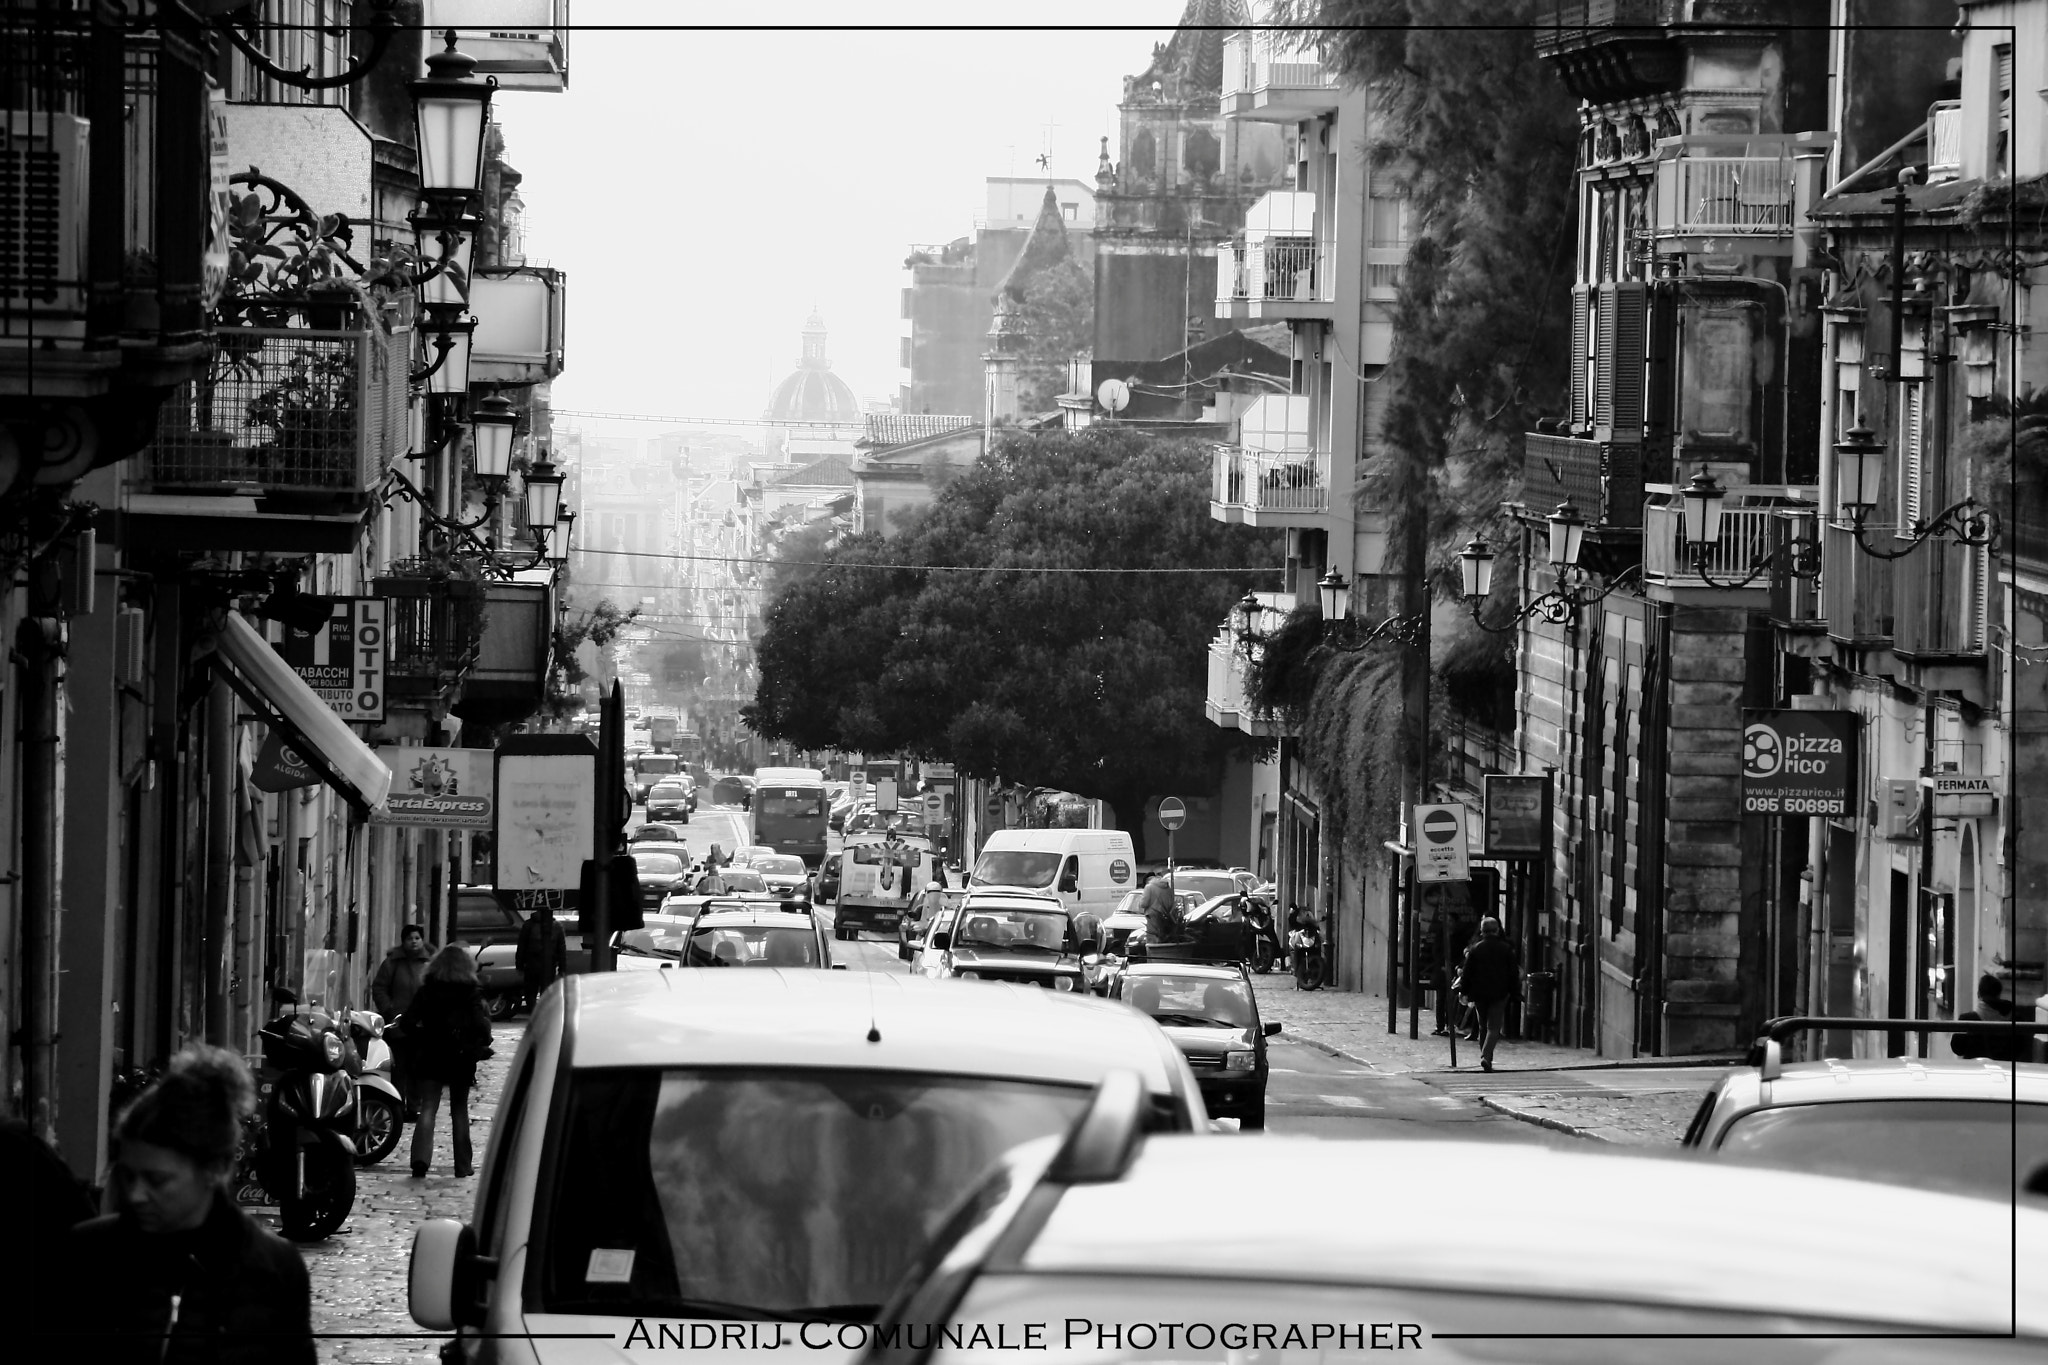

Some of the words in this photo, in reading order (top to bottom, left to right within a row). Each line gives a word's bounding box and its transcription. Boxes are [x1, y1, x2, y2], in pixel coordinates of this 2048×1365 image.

[357, 604, 380, 711] LOTTO
[294, 666, 349, 678] TABACCHI
[320, 679, 348, 687] BOLLATI
[313, 690, 353, 700] RIBUTO
[325, 702, 353, 713] ATO
[1785, 733, 1843, 758] pizza
[1784, 754, 1826, 774] rico
[273, 763, 305, 779] ALGIDA
[1937, 780, 1989, 790] FERMATA
[1745, 787, 1845, 798] www.pizzarico.it
[1745, 797, 1779, 812] 095
[1784, 798, 1845, 814] 506951
